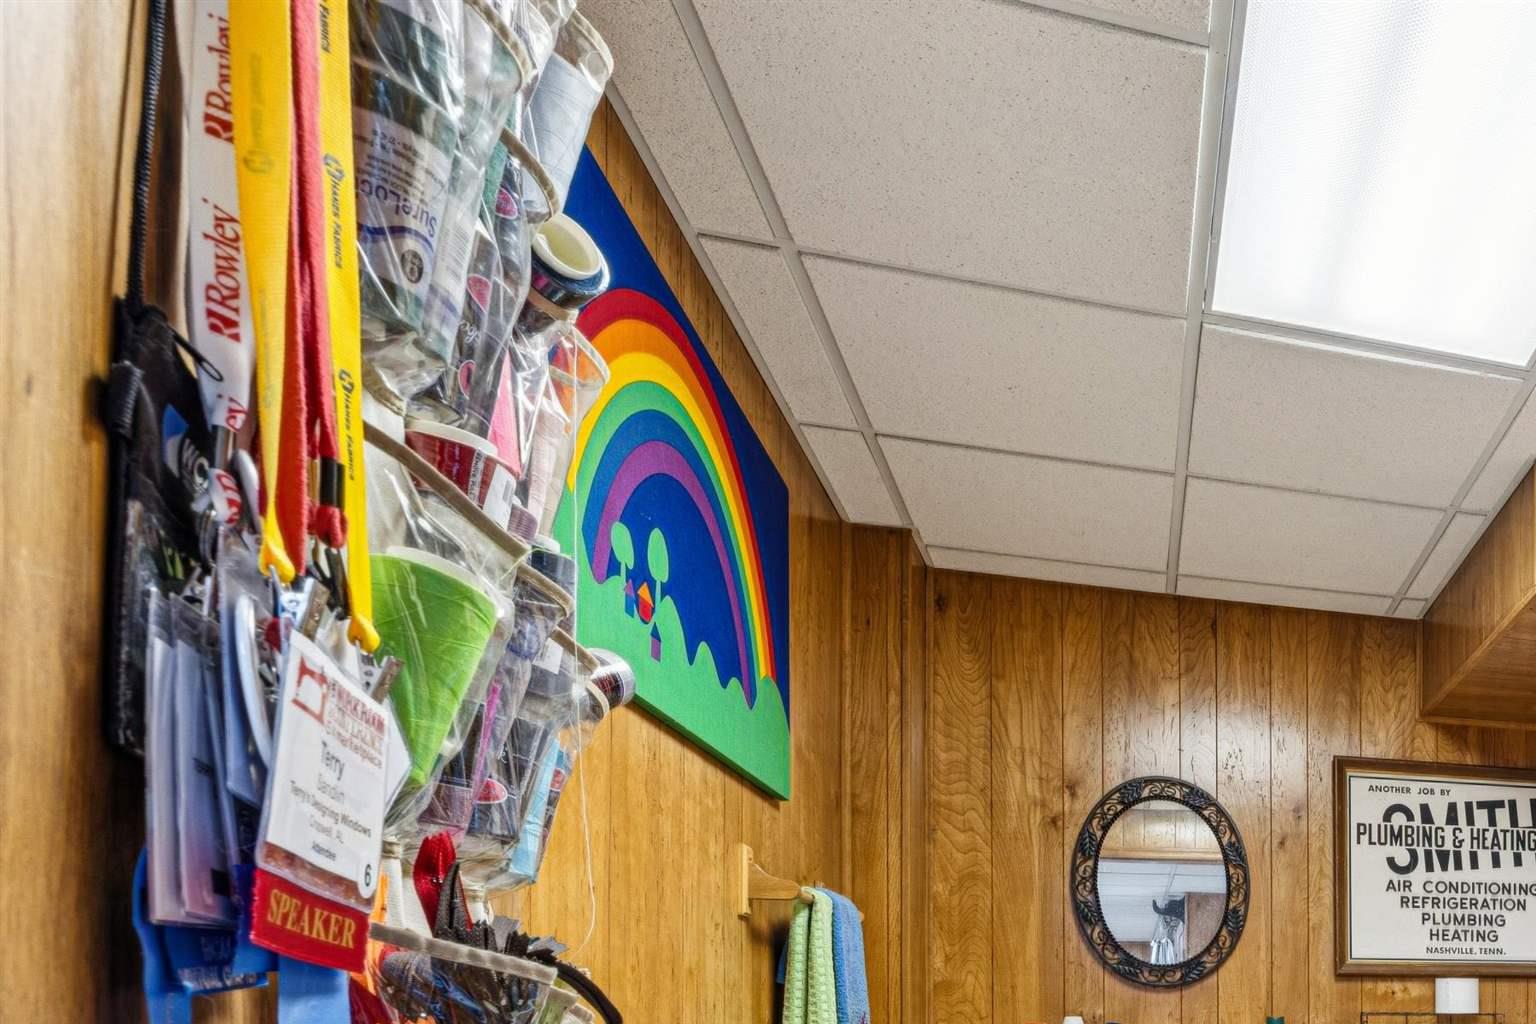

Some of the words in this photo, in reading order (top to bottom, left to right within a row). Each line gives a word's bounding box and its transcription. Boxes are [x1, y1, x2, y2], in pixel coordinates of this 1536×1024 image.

[203, 204, 241, 315] Rowley
[321, 741, 345, 781] Terry
[1368, 784, 1411, 795] ANOTHER
[1417, 787, 1435, 796] JOB
[1440, 788, 1451, 797] BY
[1356, 822, 1445, 849] PLUMBING
[1452, 827, 1465, 849] &
[364, 862, 371, 888] 6
[1385, 880, 1412, 893] AIR
[1400, 896, 1527, 911] REFRIGERATION
[267, 890, 356, 949] SPEAKER
[1421, 913, 1506, 928] PLUMBING
[1430, 928, 1499, 943] HEATING
[1426, 946, 1477, 956] NASHVILLE,
[1479, 947, 1507, 956] TENN.
